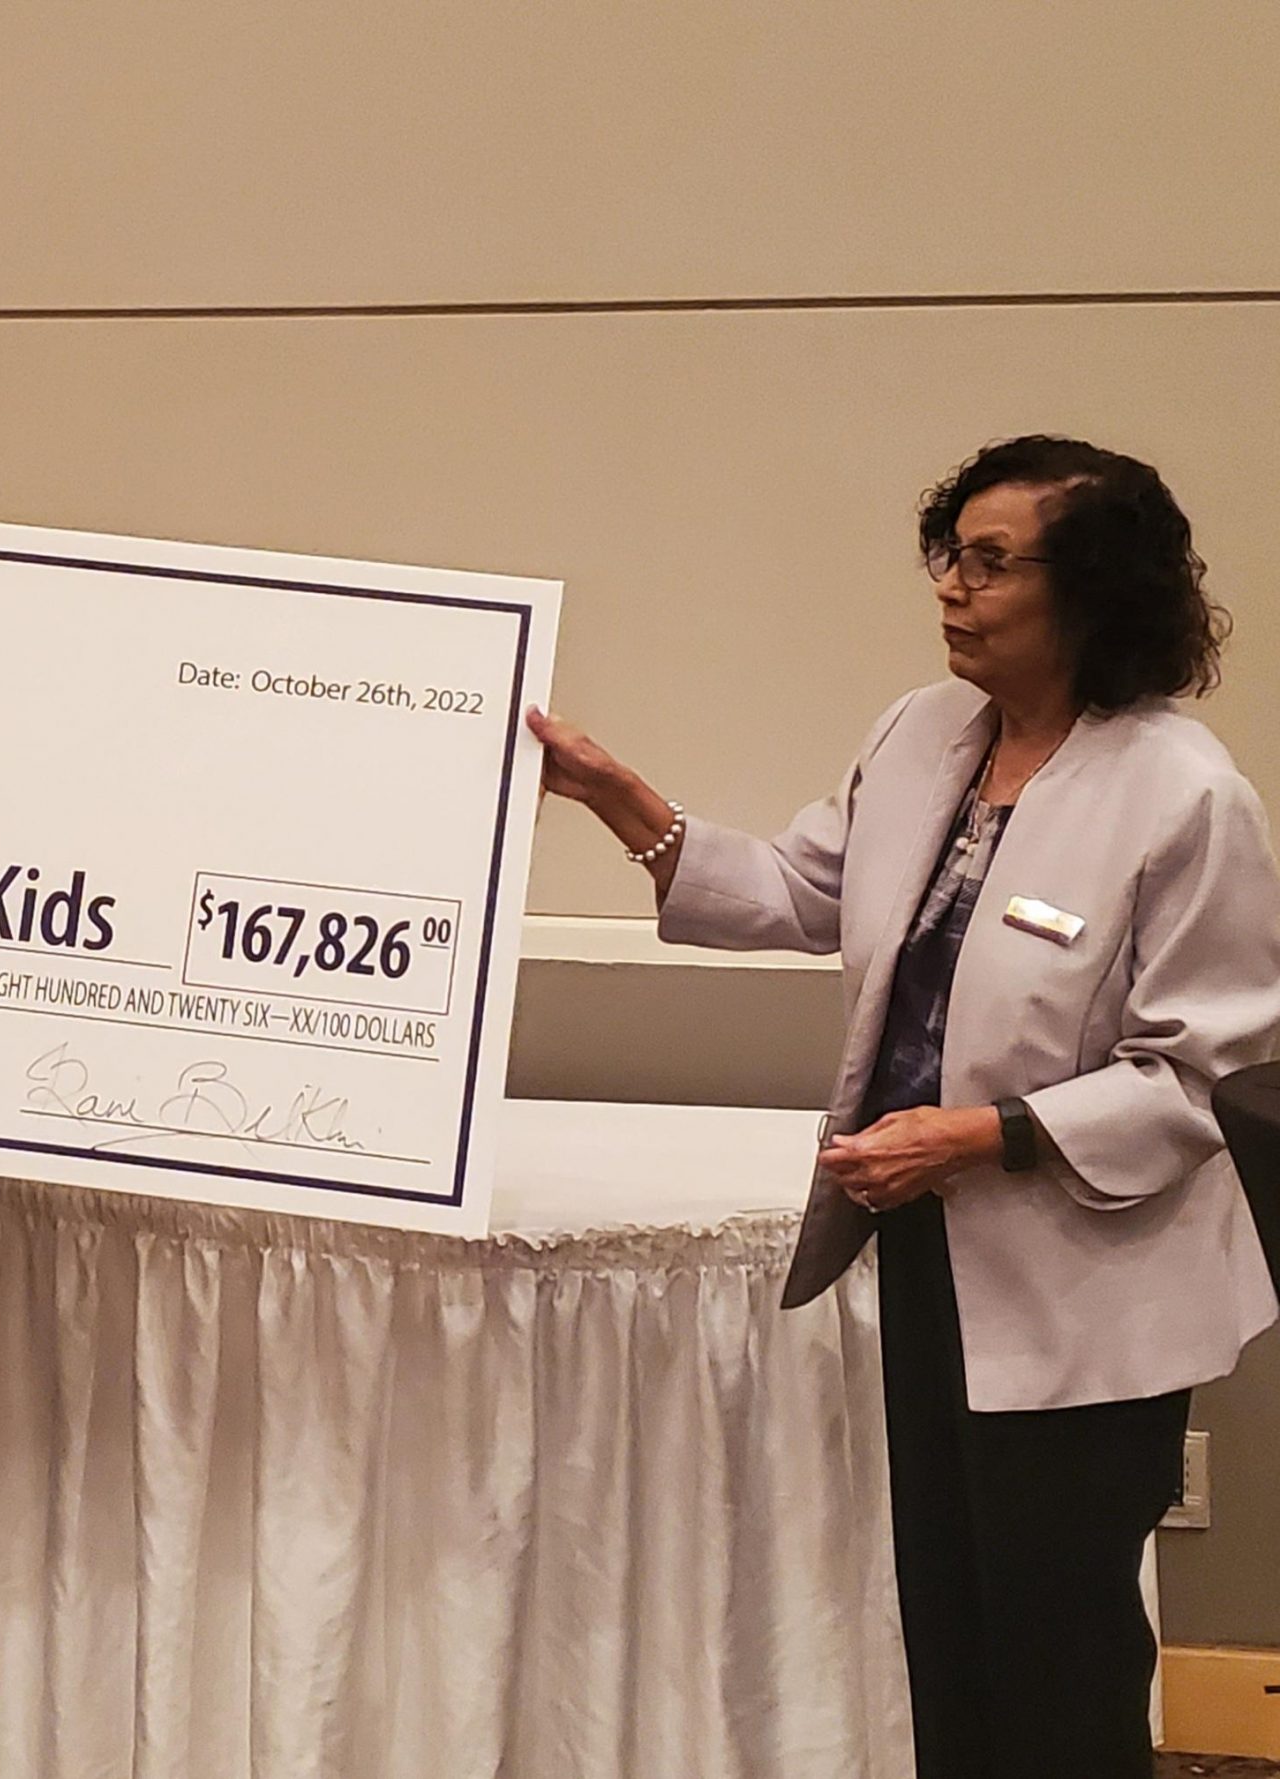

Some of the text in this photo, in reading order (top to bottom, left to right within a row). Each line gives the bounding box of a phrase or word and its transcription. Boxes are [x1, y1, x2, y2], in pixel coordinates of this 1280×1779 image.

[178, 661, 484, 715] Date: October 26th, 2022
[197, 888, 452, 979] $167,826 00
[35, 976, 120, 1010] HUNDRED
[123, 987, 164, 1016] AND
[168, 991, 241, 1027] TWENTY
[354, 1013, 436, 1049] DOLLARS
